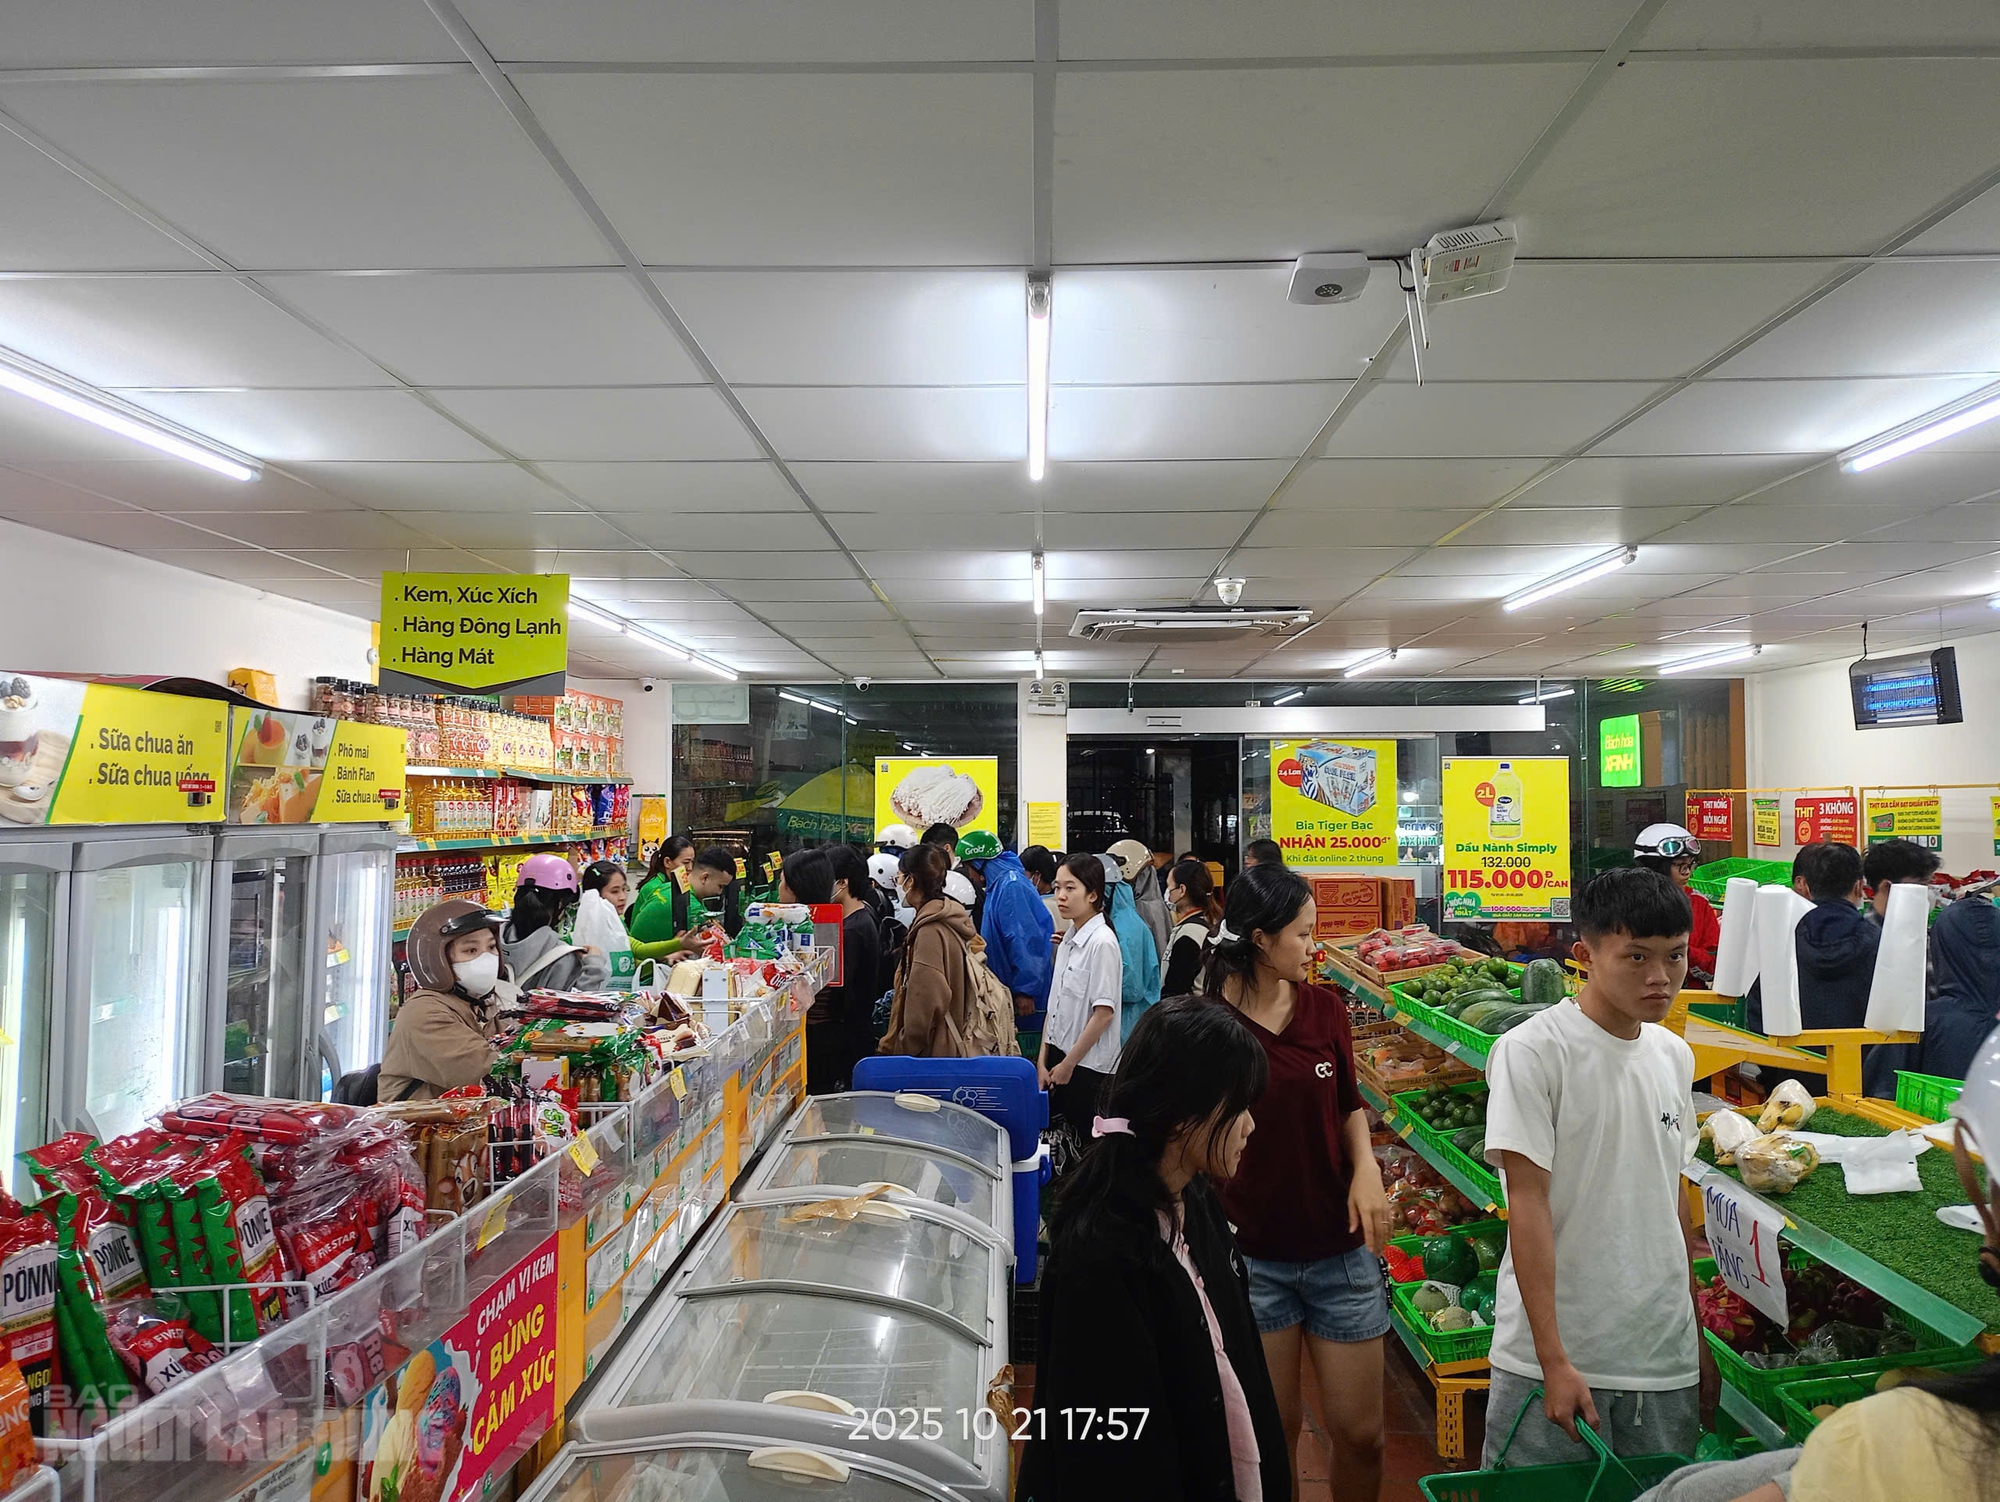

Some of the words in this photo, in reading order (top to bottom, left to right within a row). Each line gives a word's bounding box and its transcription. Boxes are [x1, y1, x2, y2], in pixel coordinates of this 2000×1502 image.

[404, 586, 452, 604] Kem,
[457, 587, 493, 603] Xúc
[497, 587, 538, 603] Xích
[403, 616, 454, 637] Hàng
[460, 618, 510, 638] Đông
[516, 618, 561, 638] Lạnh
[402, 647, 453, 668] Hàng
[459, 648, 494, 664] Mát
[99, 728, 131, 751] Sữa
[135, 731, 173, 754] chua
[177, 734, 193, 755] ăn
[338, 743, 353, 757] Phô
[355, 746, 369, 758] mai
[97, 763, 129, 785] Sữa
[134, 764, 171, 786] chua
[337, 766, 357, 780] Bánh
[359, 767, 375, 781] Flan
[336, 790, 351, 803] Sữa
[352, 790, 371, 803] chua
[1477, 787, 1493, 798] 2L
[1795, 806, 1815, 821] THỊT
[1819, 803, 1825, 815] 3
[1825, 800, 1854, 815] KHÔNG
[788, 815, 817, 829] Bách
[1296, 821, 1314, 830] Bia
[1318, 820, 1348, 831] Tiger
[1351, 821, 1373, 832] Bạc
[965, 845, 985, 855] Grab
[1279, 834, 1325, 851] NHẬN
[1483, 843, 1513, 852] Nành
[1517, 843, 1557, 854] Simply
[1356, 855, 1384, 863] thùng
[1481, 856, 1531, 868] 132.000
[1447, 869, 1543, 889] 115.000
[1544, 880, 1568, 888] /CAN
[1707, 1186, 1740, 1238] MUA
[331, 1231, 357, 1249] STAR
[1711, 1237, 1750, 1290] TẶNG
[1750, 1220, 1771, 1288] 1
[477, 1277, 516, 1337] CHẠM
[518, 1264, 532, 1294] VỊ
[532, 1251, 556, 1285] KEM
[490, 1303, 545, 1382] BÙNG
[473, 1381, 516, 1456] CẢM
[519, 1346, 556, 1404] XÚC
